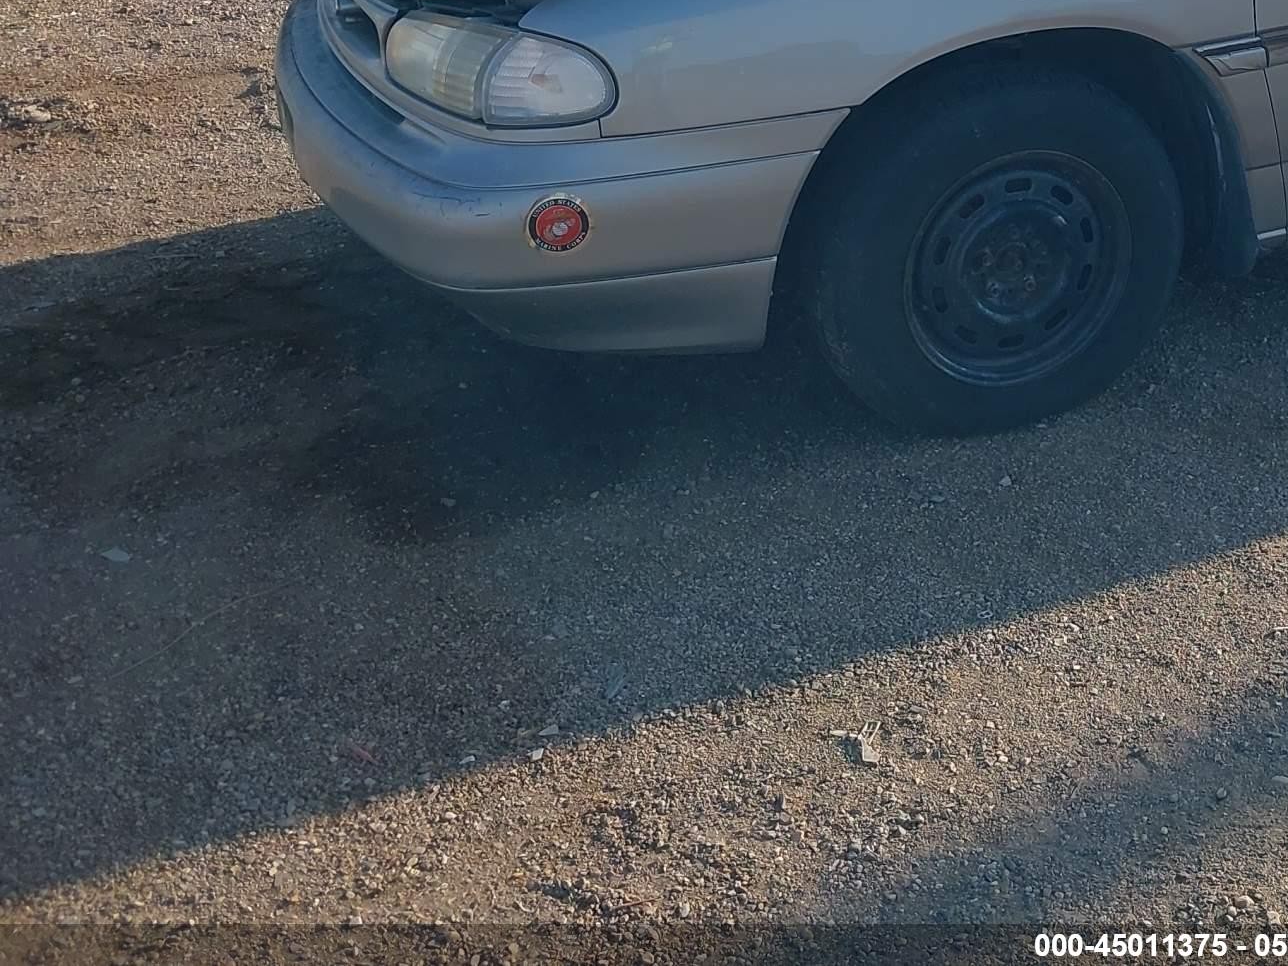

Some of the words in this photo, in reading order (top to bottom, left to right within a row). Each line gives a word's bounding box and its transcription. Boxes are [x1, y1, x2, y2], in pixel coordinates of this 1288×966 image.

[533, 200, 555, 218] UNITED
[558, 200, 581, 212] STATES
[536, 237, 561, 251] MARINE
